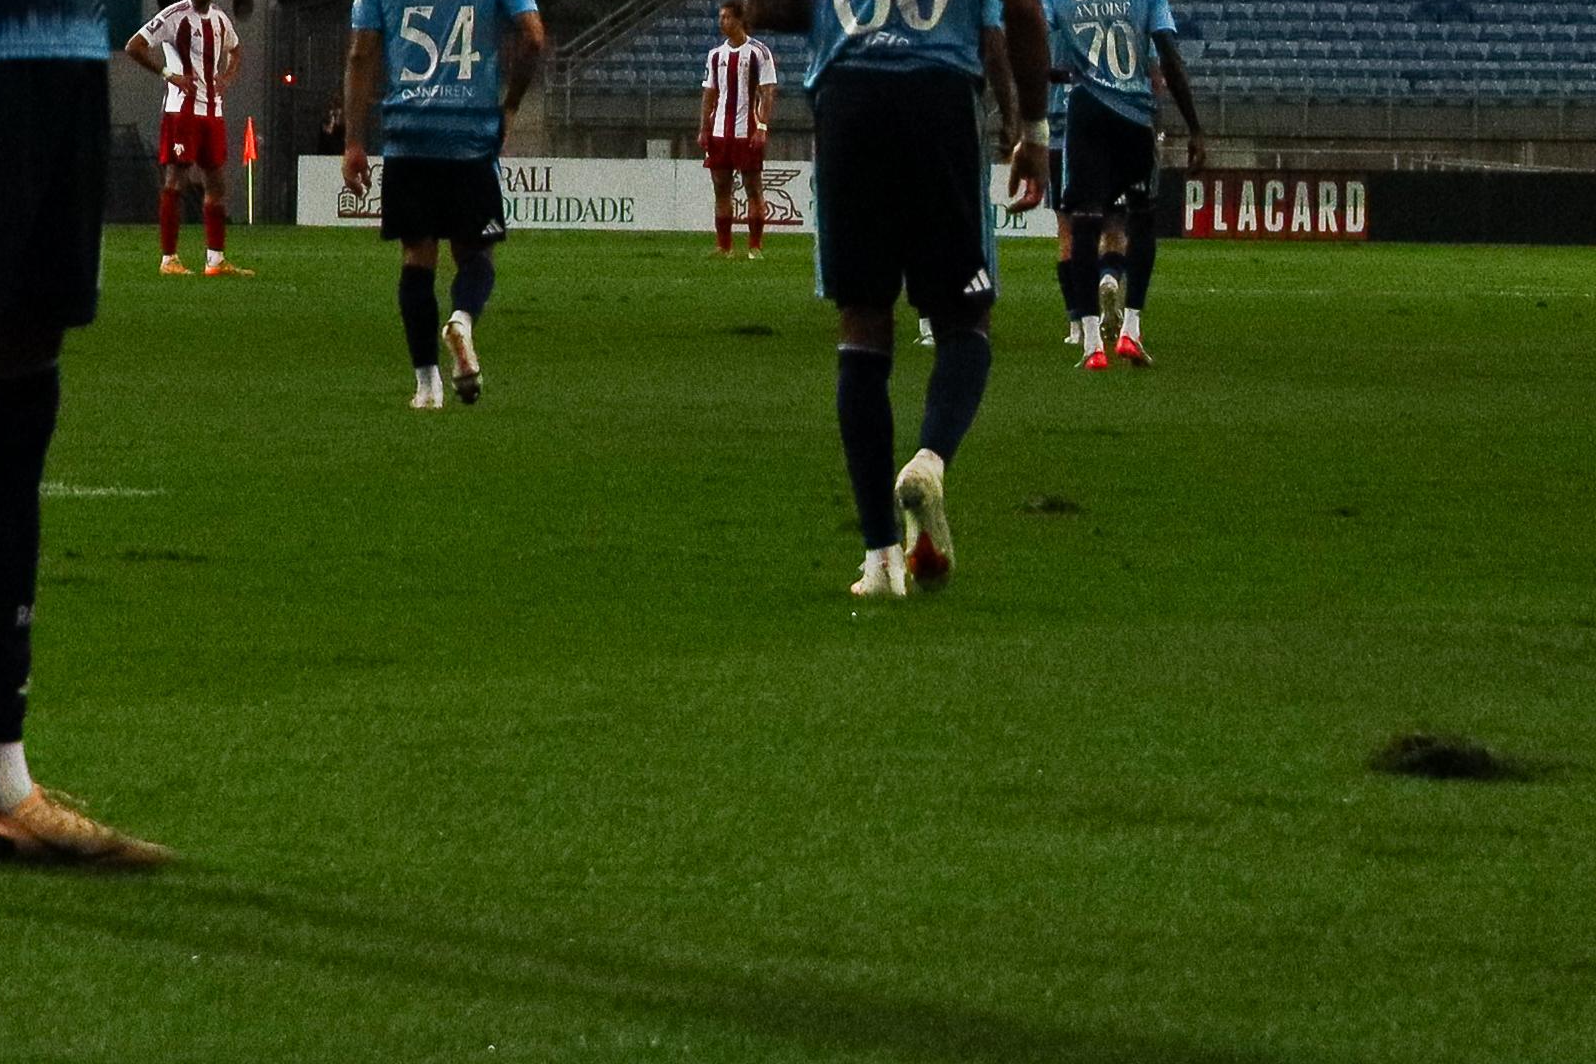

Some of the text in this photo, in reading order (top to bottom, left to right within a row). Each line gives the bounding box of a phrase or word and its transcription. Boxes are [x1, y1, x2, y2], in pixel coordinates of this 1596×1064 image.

[400, 5, 481, 81] 54
[1073, 20, 1137, 80] 70
[1185, 180, 1366, 232] PLACARD
